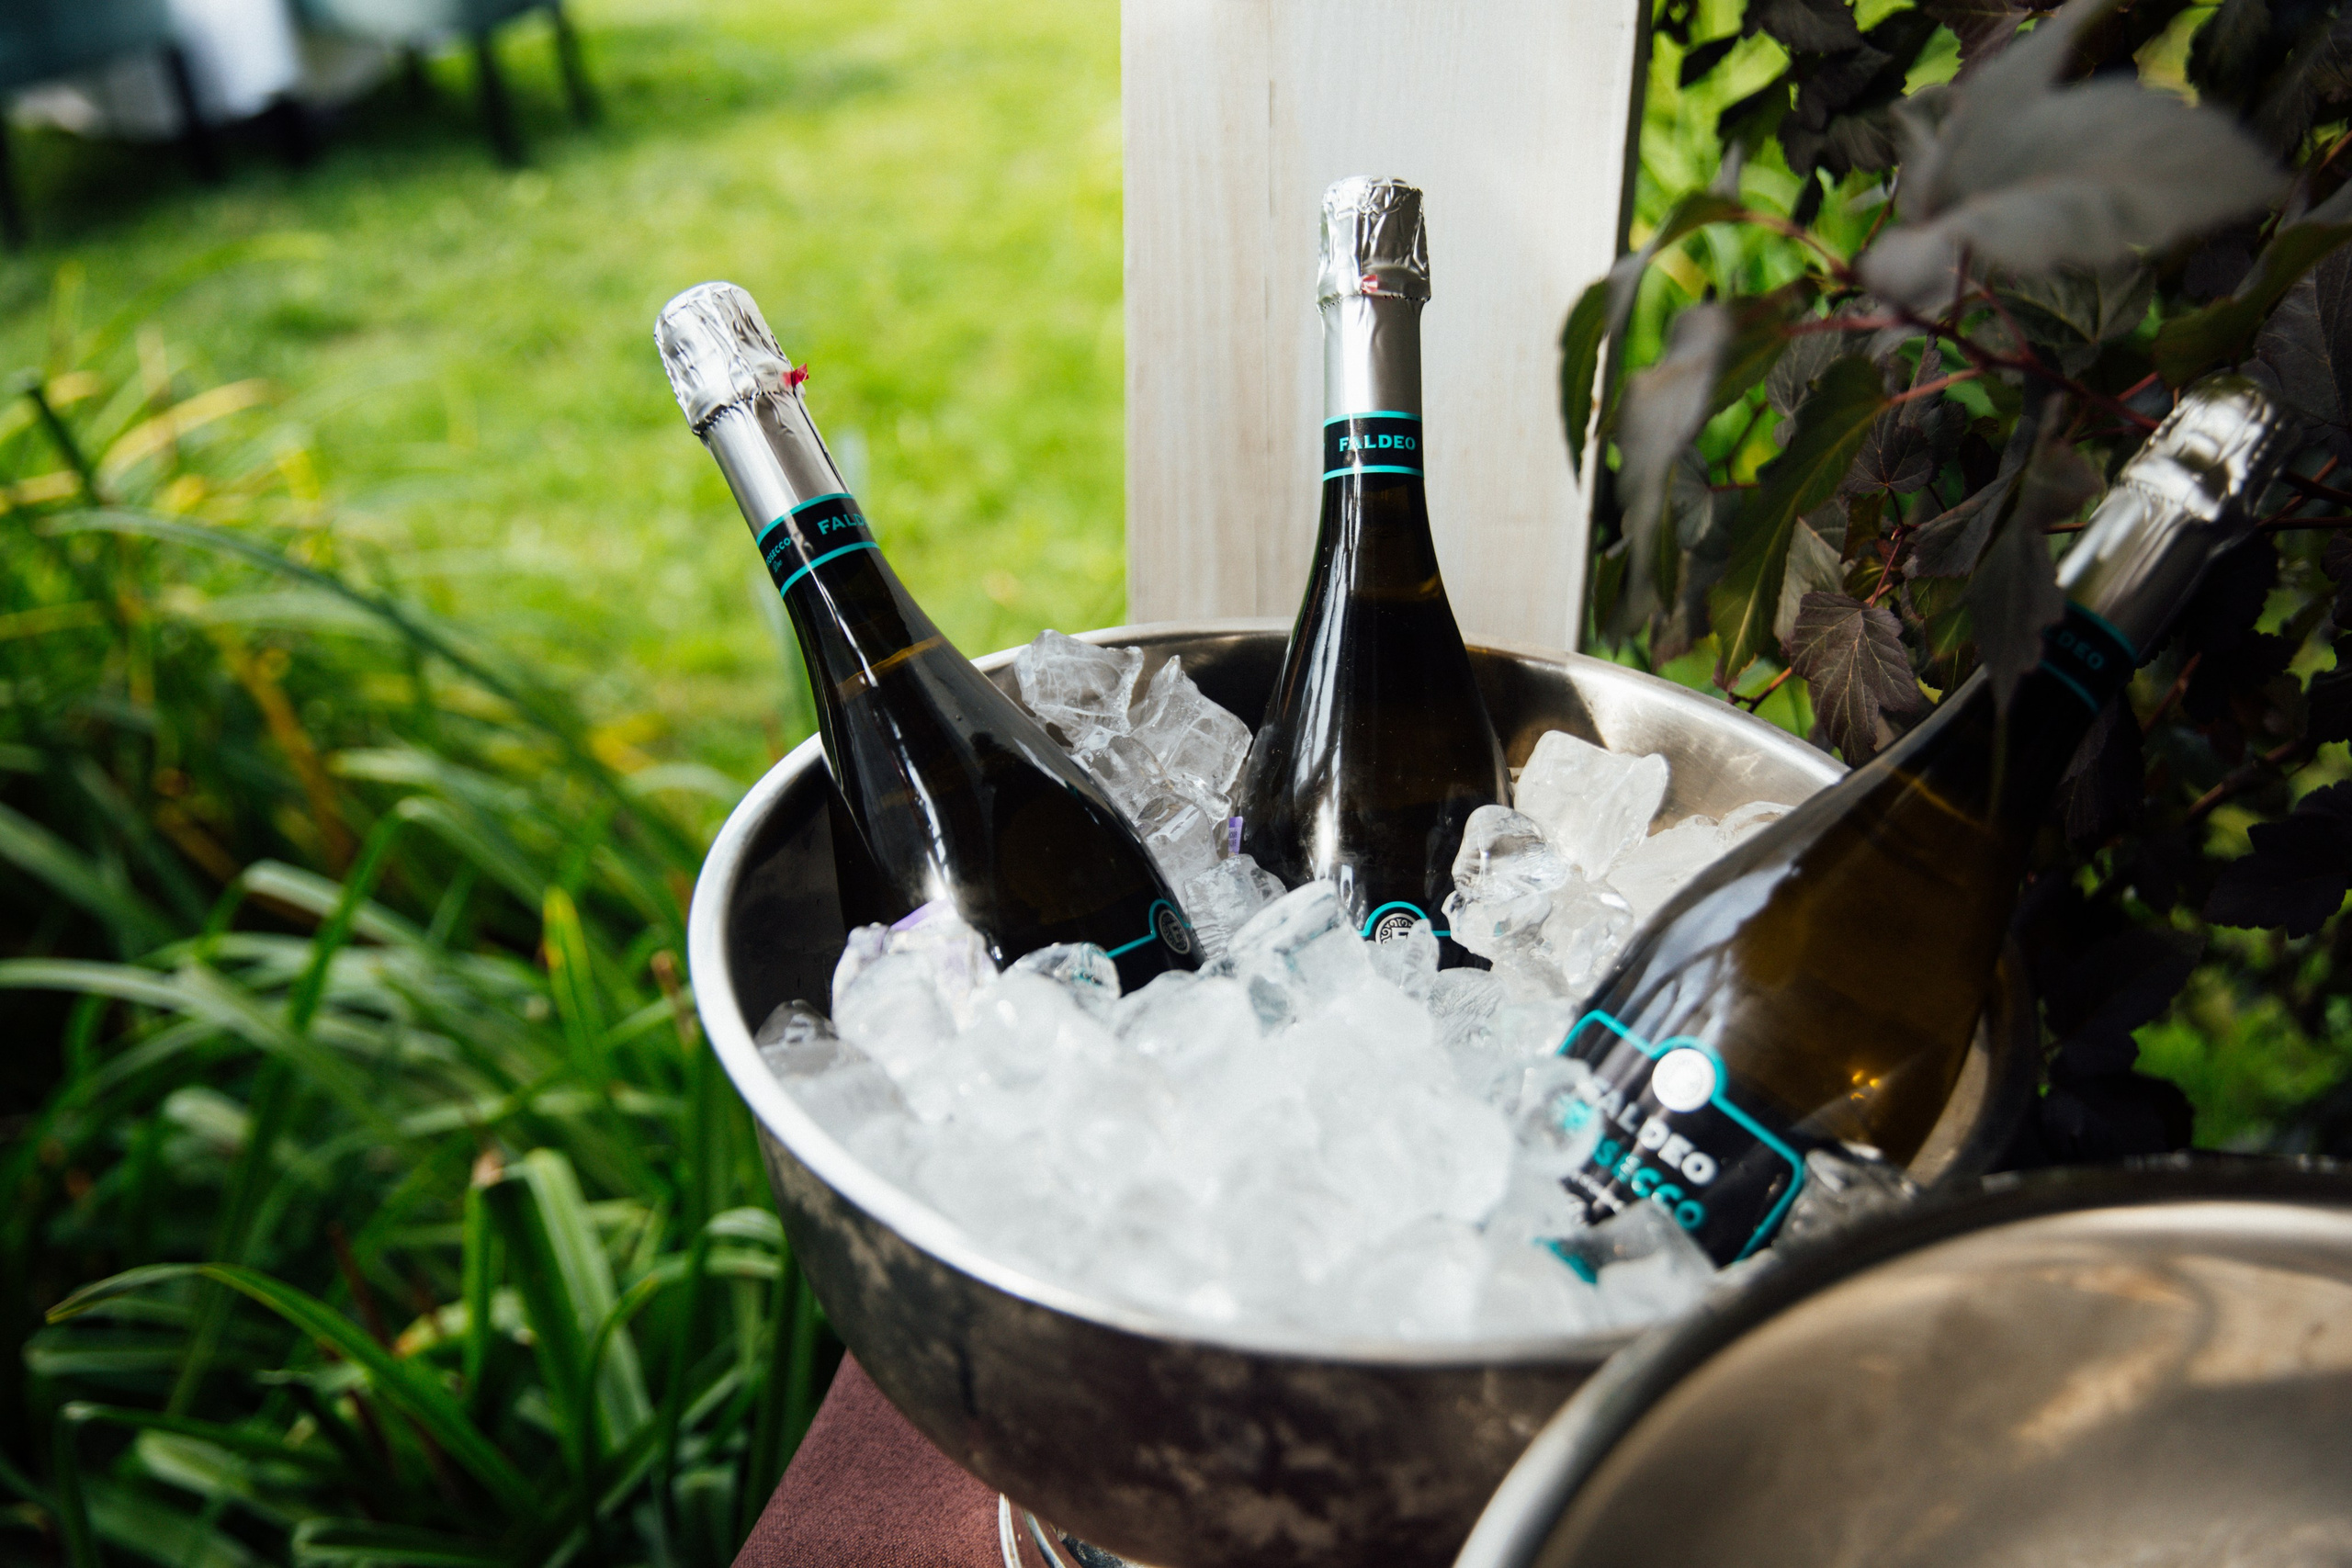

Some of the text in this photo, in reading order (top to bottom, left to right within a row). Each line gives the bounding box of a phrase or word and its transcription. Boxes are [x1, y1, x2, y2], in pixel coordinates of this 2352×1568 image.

[1339, 434, 1416, 452] FALDEO
[817, 513, 866, 536] FALD
[2042, 626, 2105, 671] DEO
[1593, 1135, 1706, 1231] SECCO
